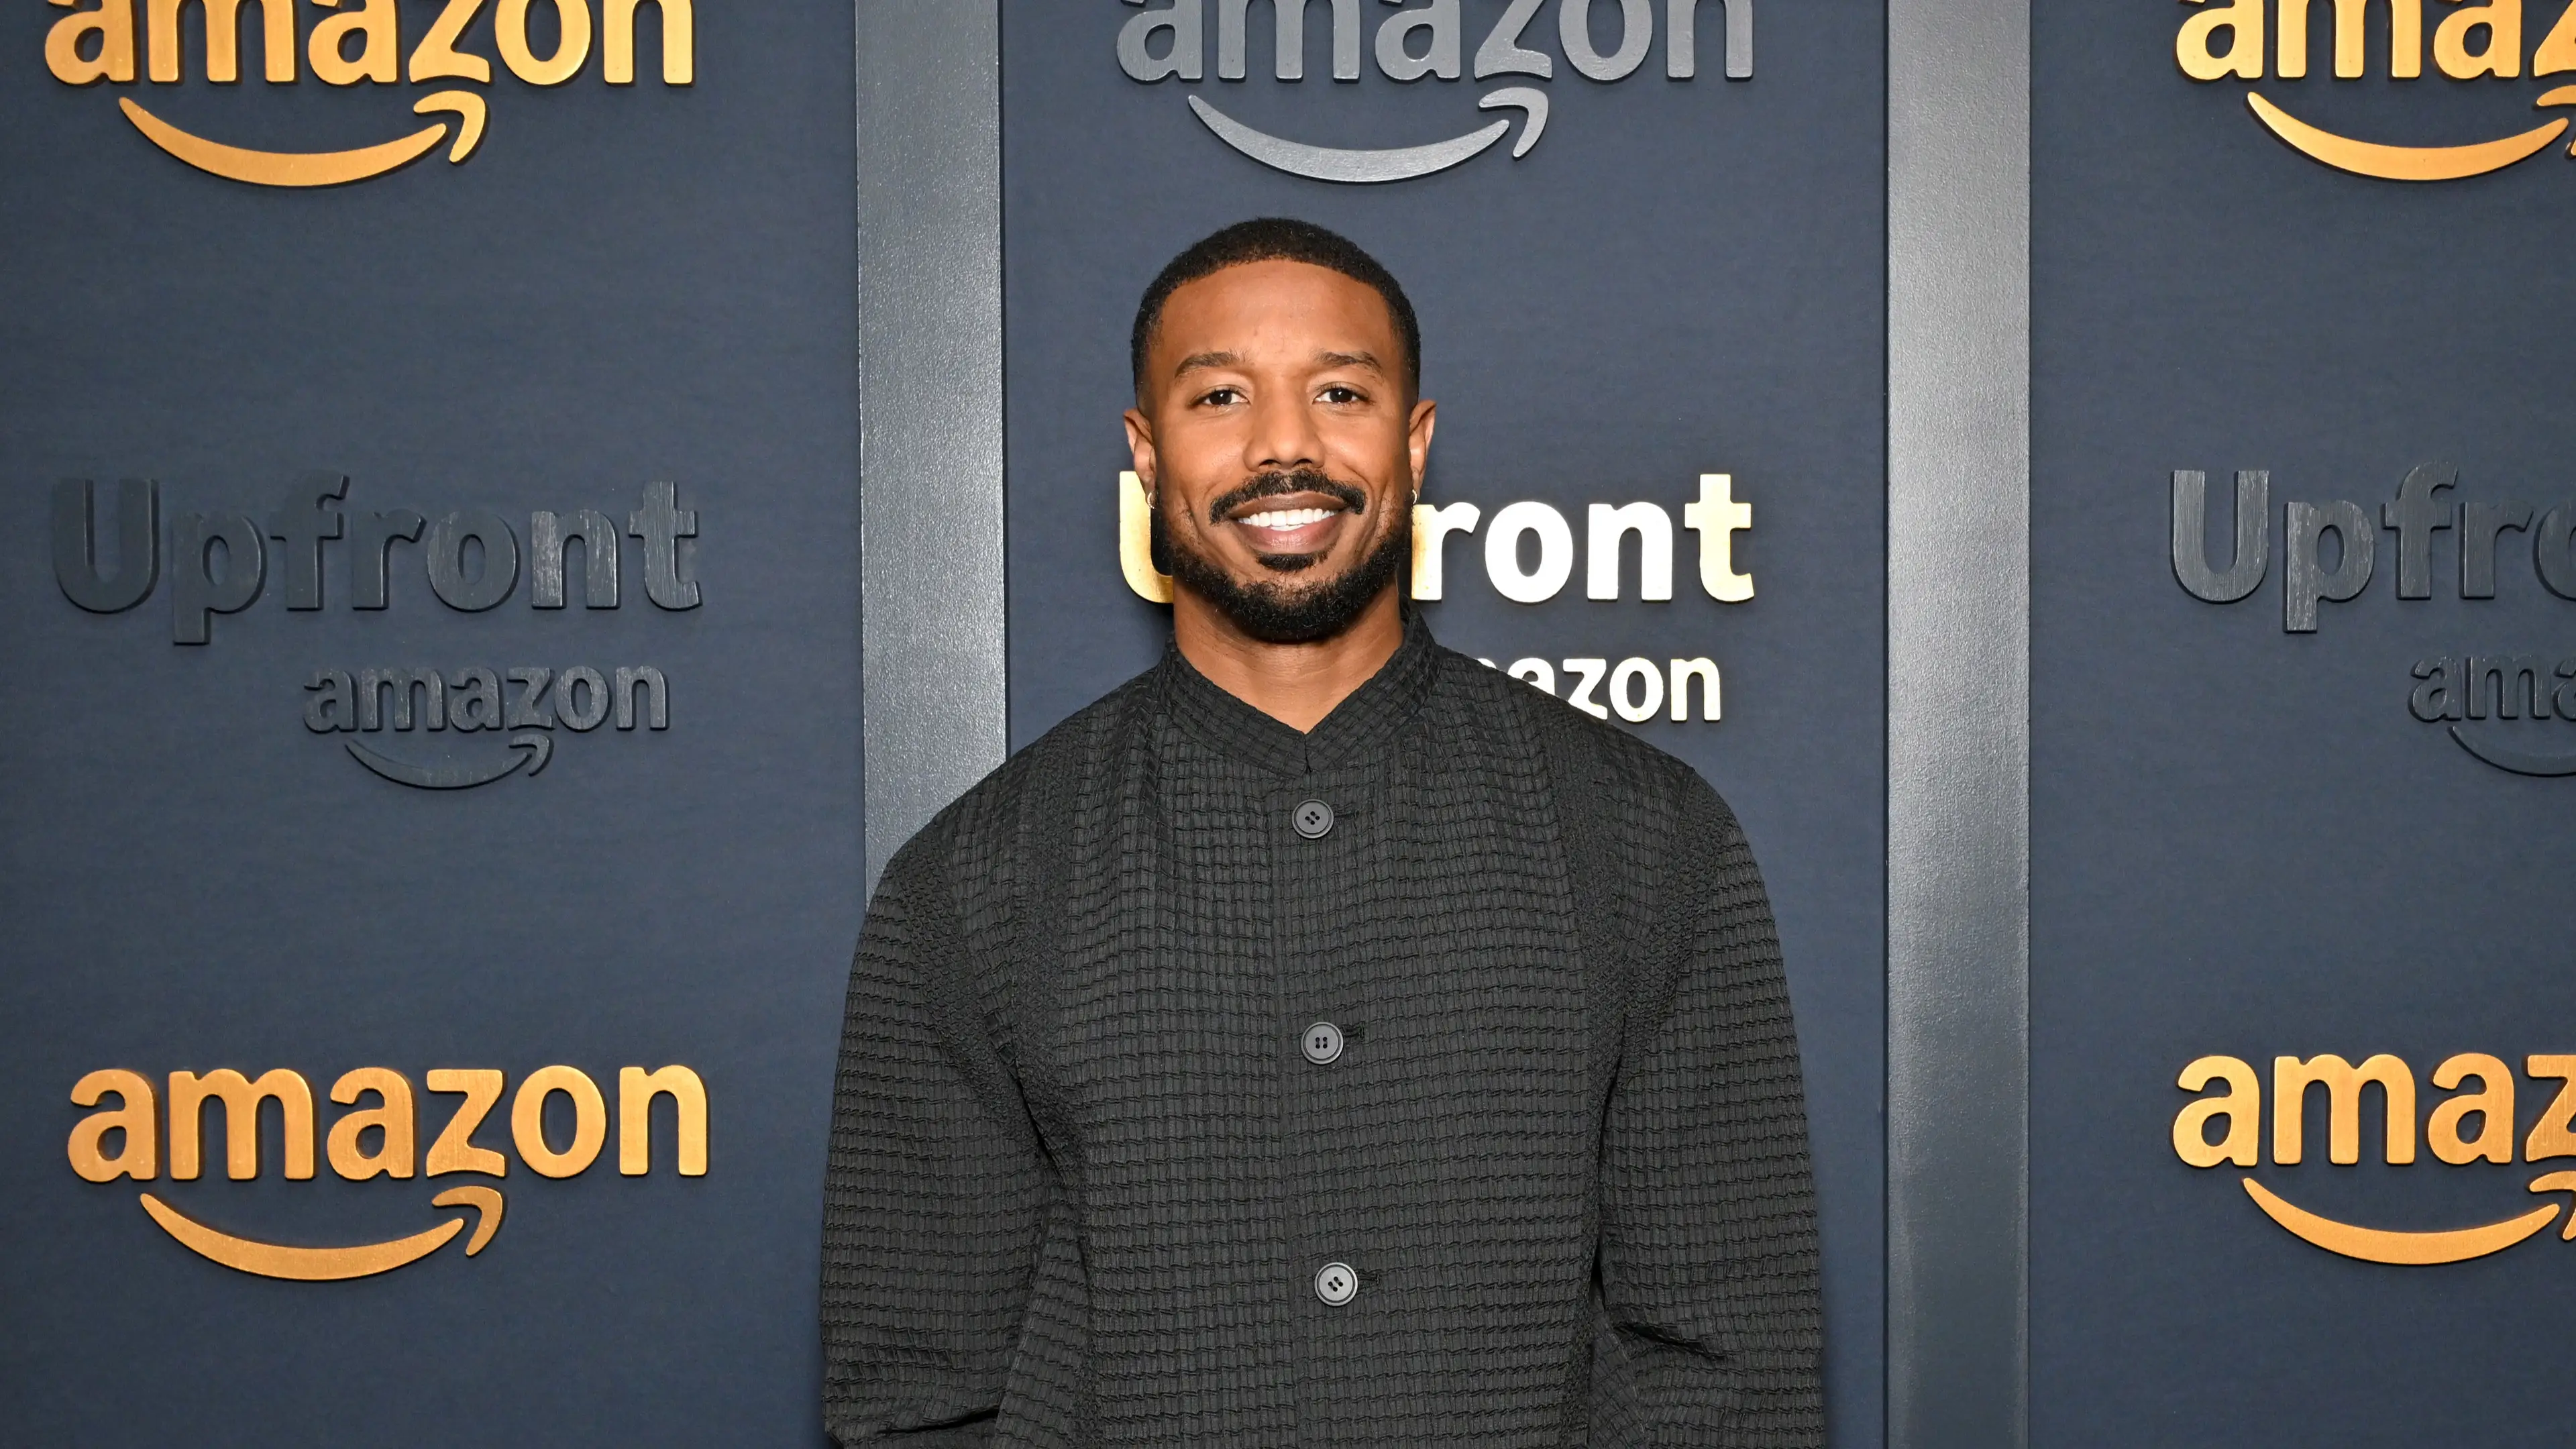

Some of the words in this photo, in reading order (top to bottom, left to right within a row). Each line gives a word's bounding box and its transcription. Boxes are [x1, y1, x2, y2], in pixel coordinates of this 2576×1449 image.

[45, 0, 694, 85] amazon
[1117, 0, 1753, 82] amazon
[53, 468, 702, 644] Upfront
[1120, 471, 1754, 602] ront
[303, 665, 667, 733] amazon
[1476, 657, 1721, 722] zon
[68, 1065, 708, 1183] amazon
